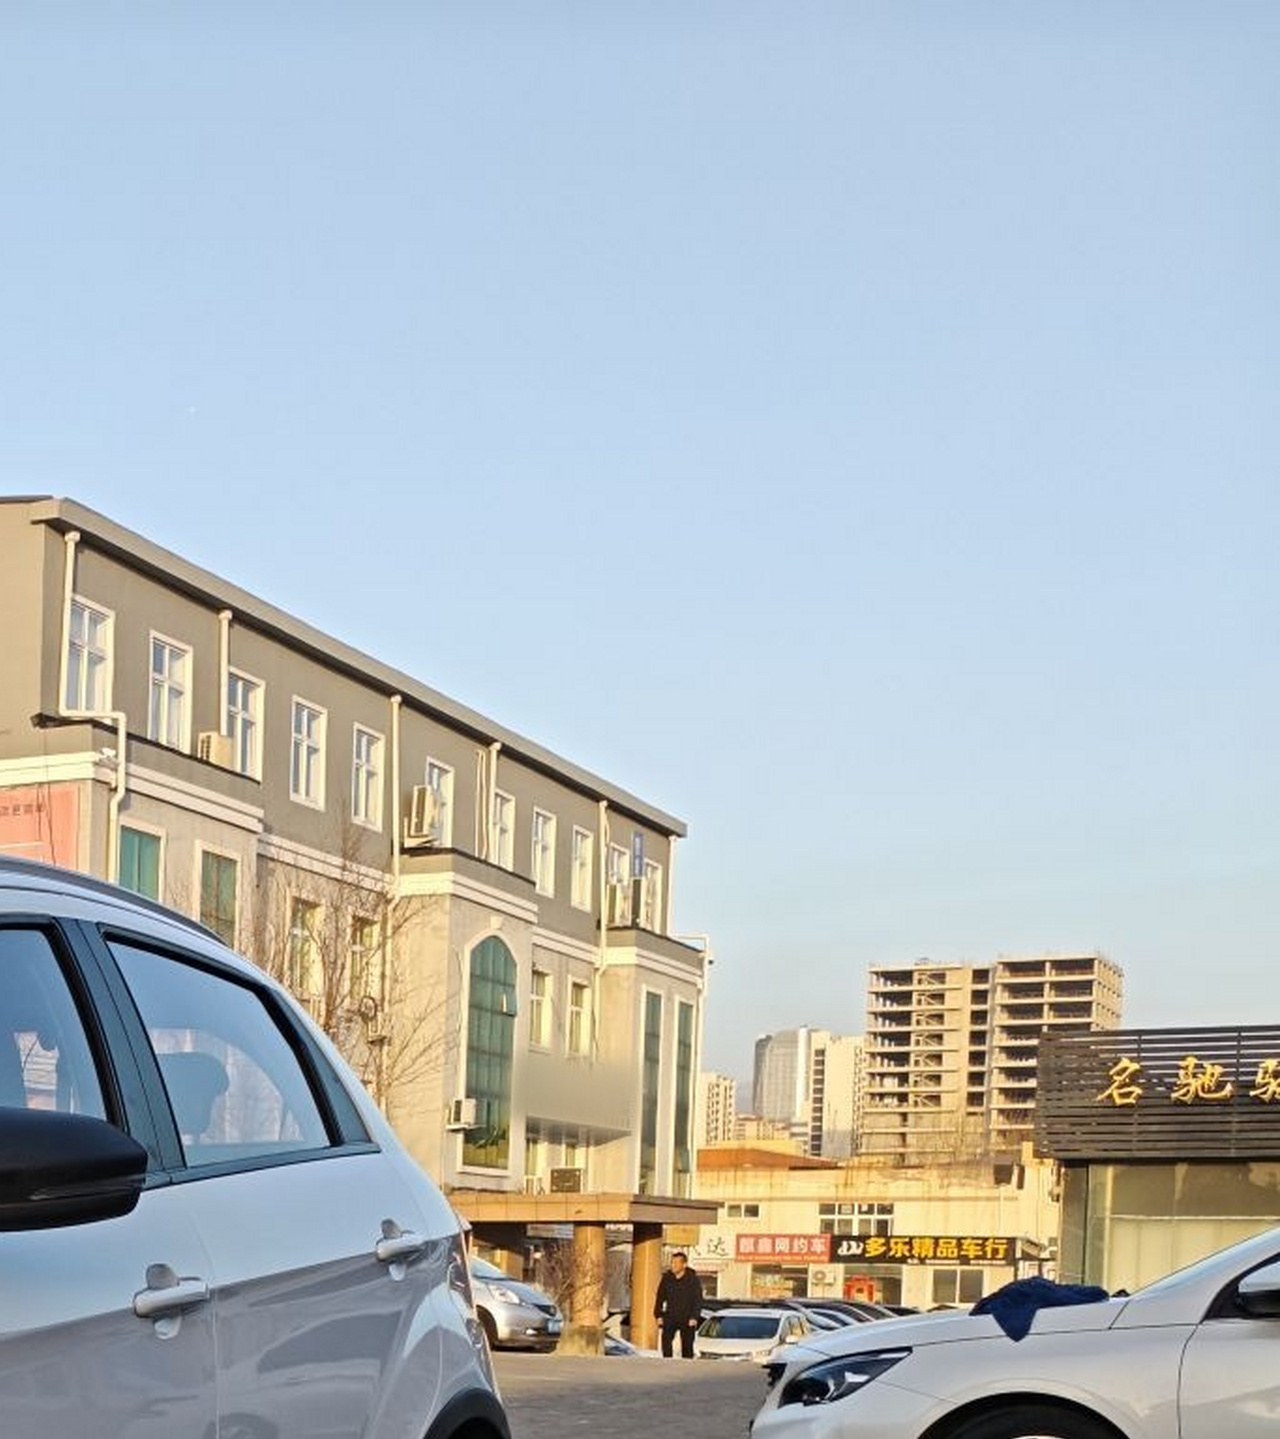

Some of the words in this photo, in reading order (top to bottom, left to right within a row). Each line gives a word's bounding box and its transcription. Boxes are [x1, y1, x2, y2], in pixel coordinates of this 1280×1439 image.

[864, 1236, 1009, 1259] 多乐精品车行
